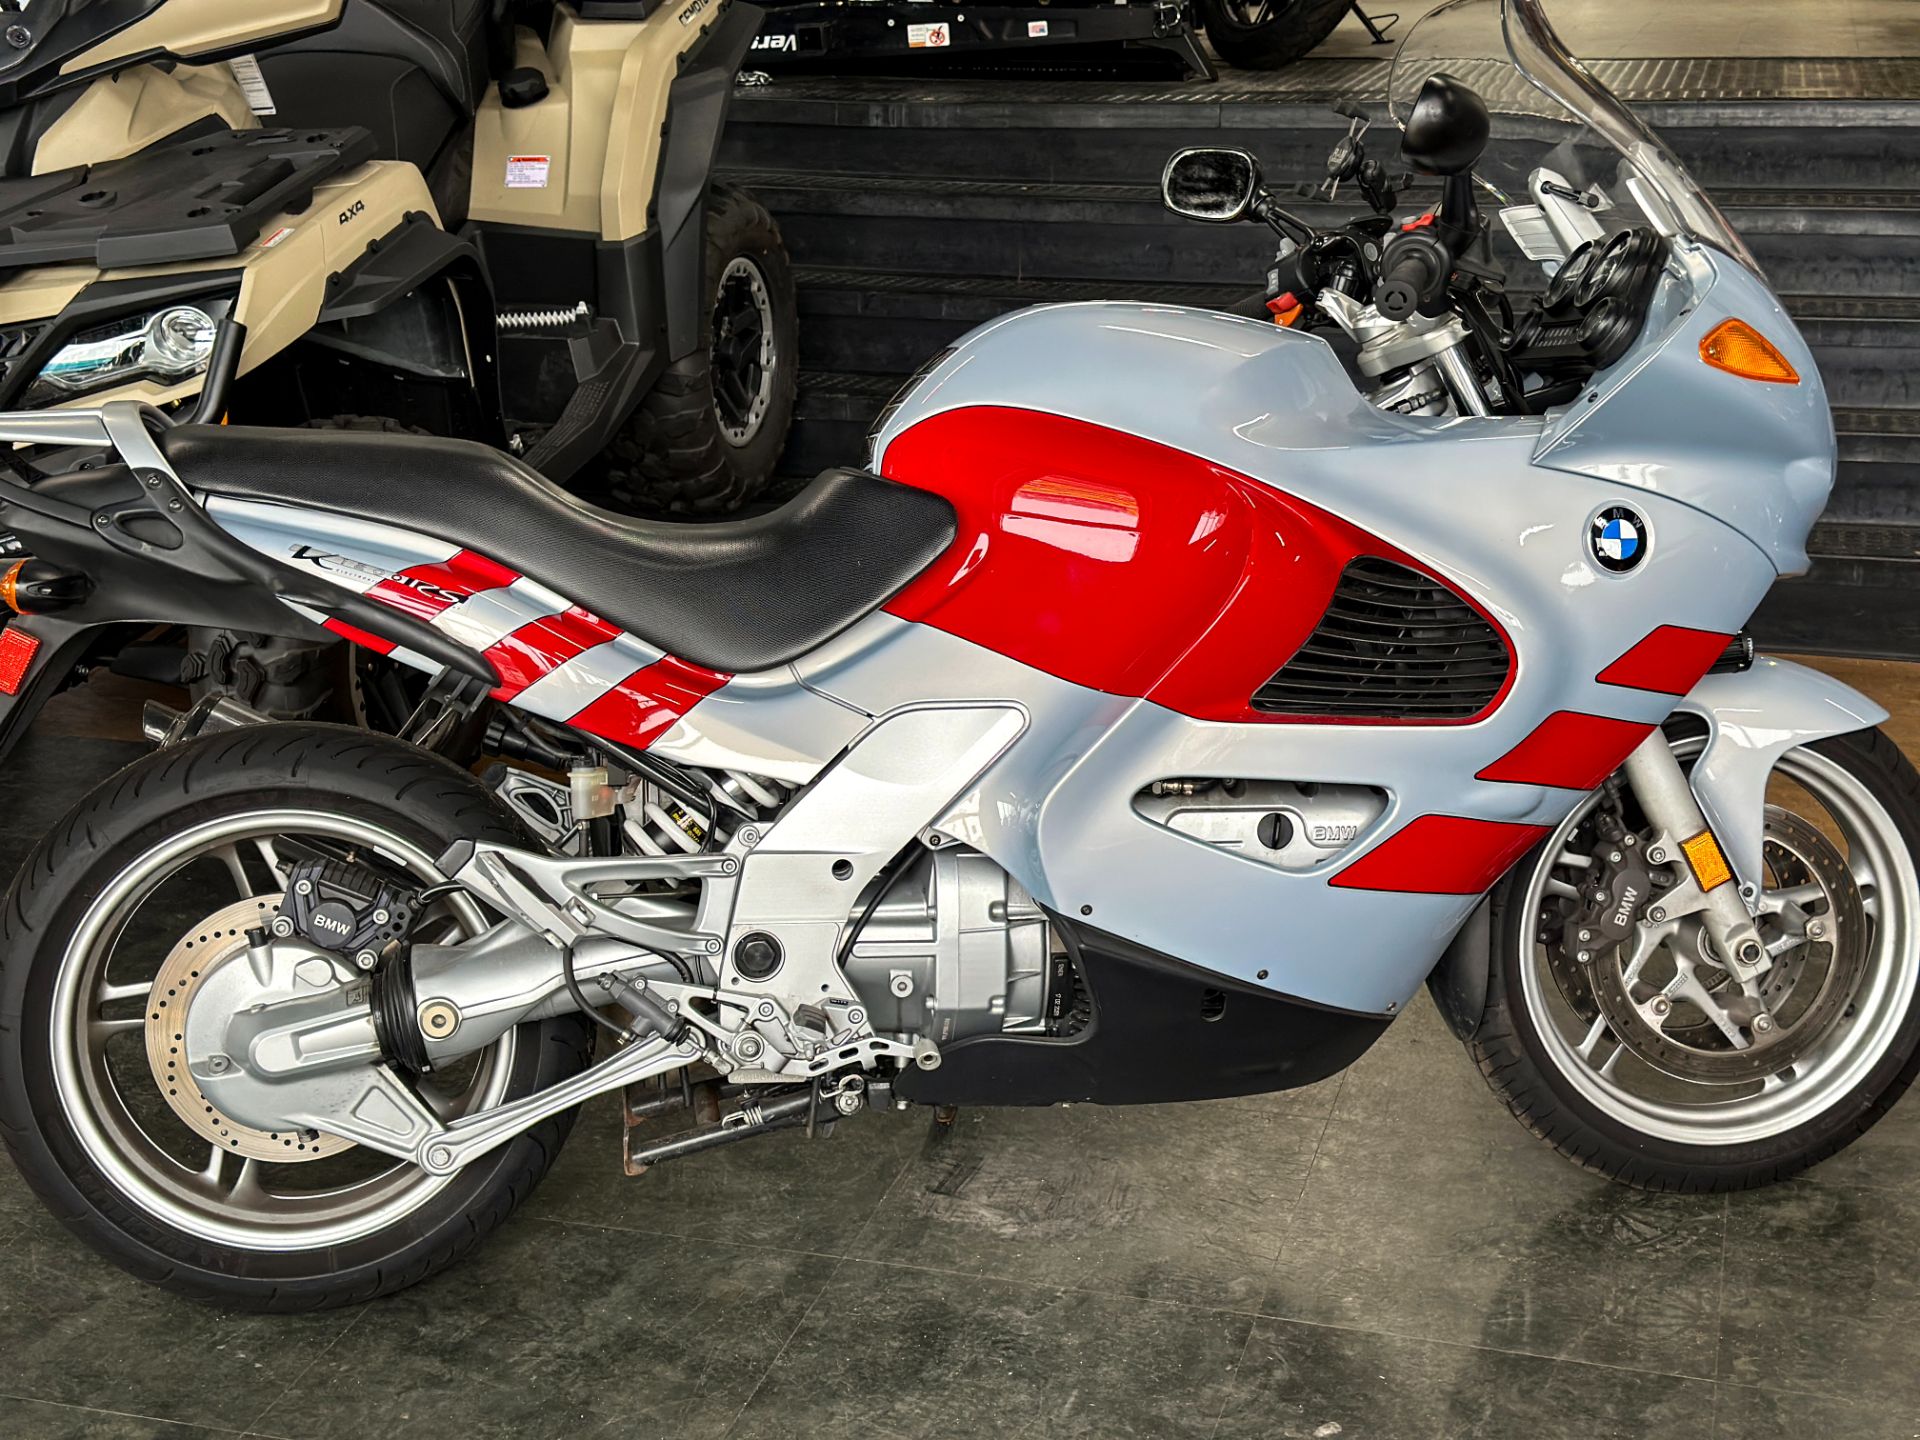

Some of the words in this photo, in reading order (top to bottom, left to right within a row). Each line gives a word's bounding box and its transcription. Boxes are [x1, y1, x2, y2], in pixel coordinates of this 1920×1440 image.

[1313, 825, 1357, 841] BMW
[1613, 886, 1638, 927] BMW
[313, 913, 351, 936] BMW
